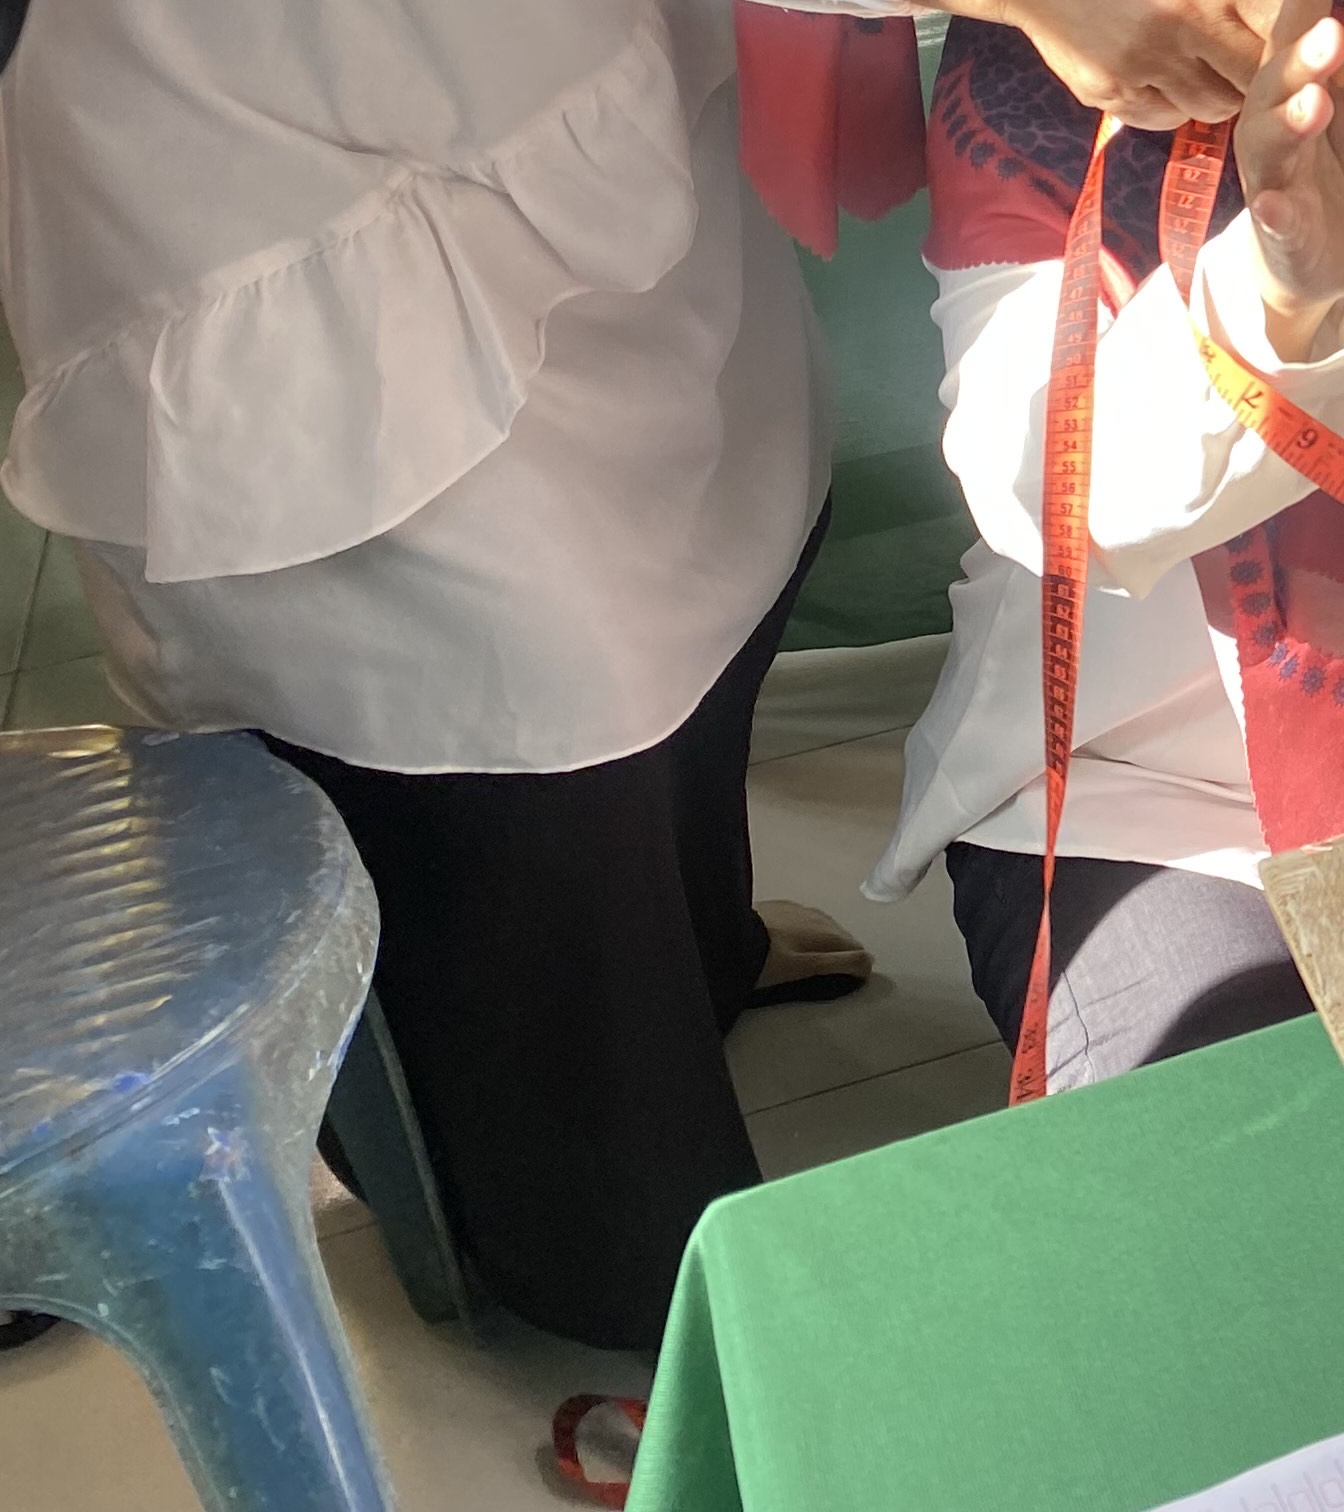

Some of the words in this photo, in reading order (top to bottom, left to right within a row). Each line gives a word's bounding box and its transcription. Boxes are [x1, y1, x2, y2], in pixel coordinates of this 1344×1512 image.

[1065, 375, 1078, 386] 51
[1065, 397, 1079, 409] 52
[1243, 389, 1264, 409] 7
[1064, 419, 1077, 431] 53
[1297, 428, 1318, 450] 6
[1063, 441, 1077, 451] 54
[1062, 462, 1076, 473] 55
[1062, 483, 1075, 494] 56
[1060, 504, 1073, 515] 57
[1059, 525, 1072, 537] 58
